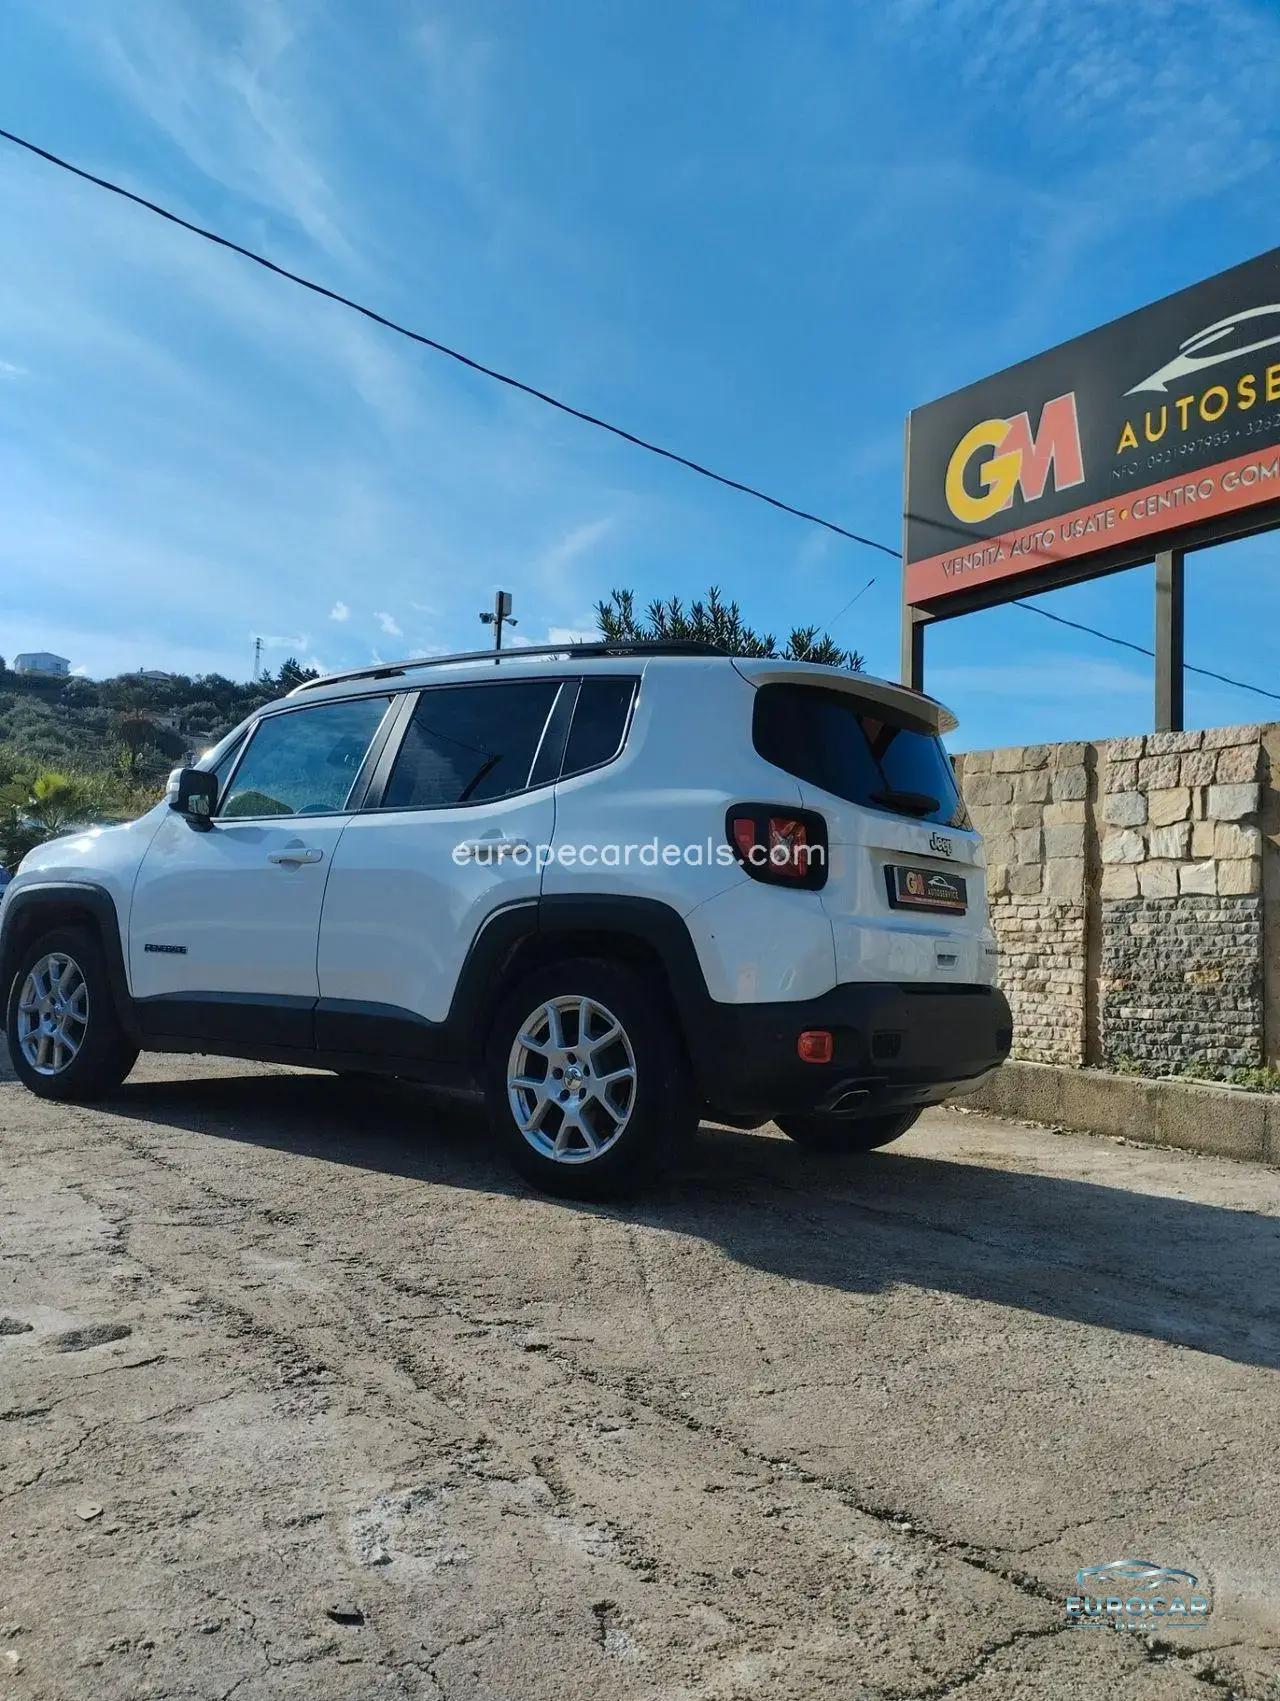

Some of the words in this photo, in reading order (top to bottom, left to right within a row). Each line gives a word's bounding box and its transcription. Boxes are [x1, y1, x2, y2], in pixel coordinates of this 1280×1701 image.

[945, 391, 1085, 523] GM
[942, 544, 1005, 578] VENDITA
[1010, 529, 1055, 558] AUTO
[1060, 508, 1116, 541] USATE
[1131, 479, 1214, 520] CENTRO
[929, 831, 953, 857] Jeep
